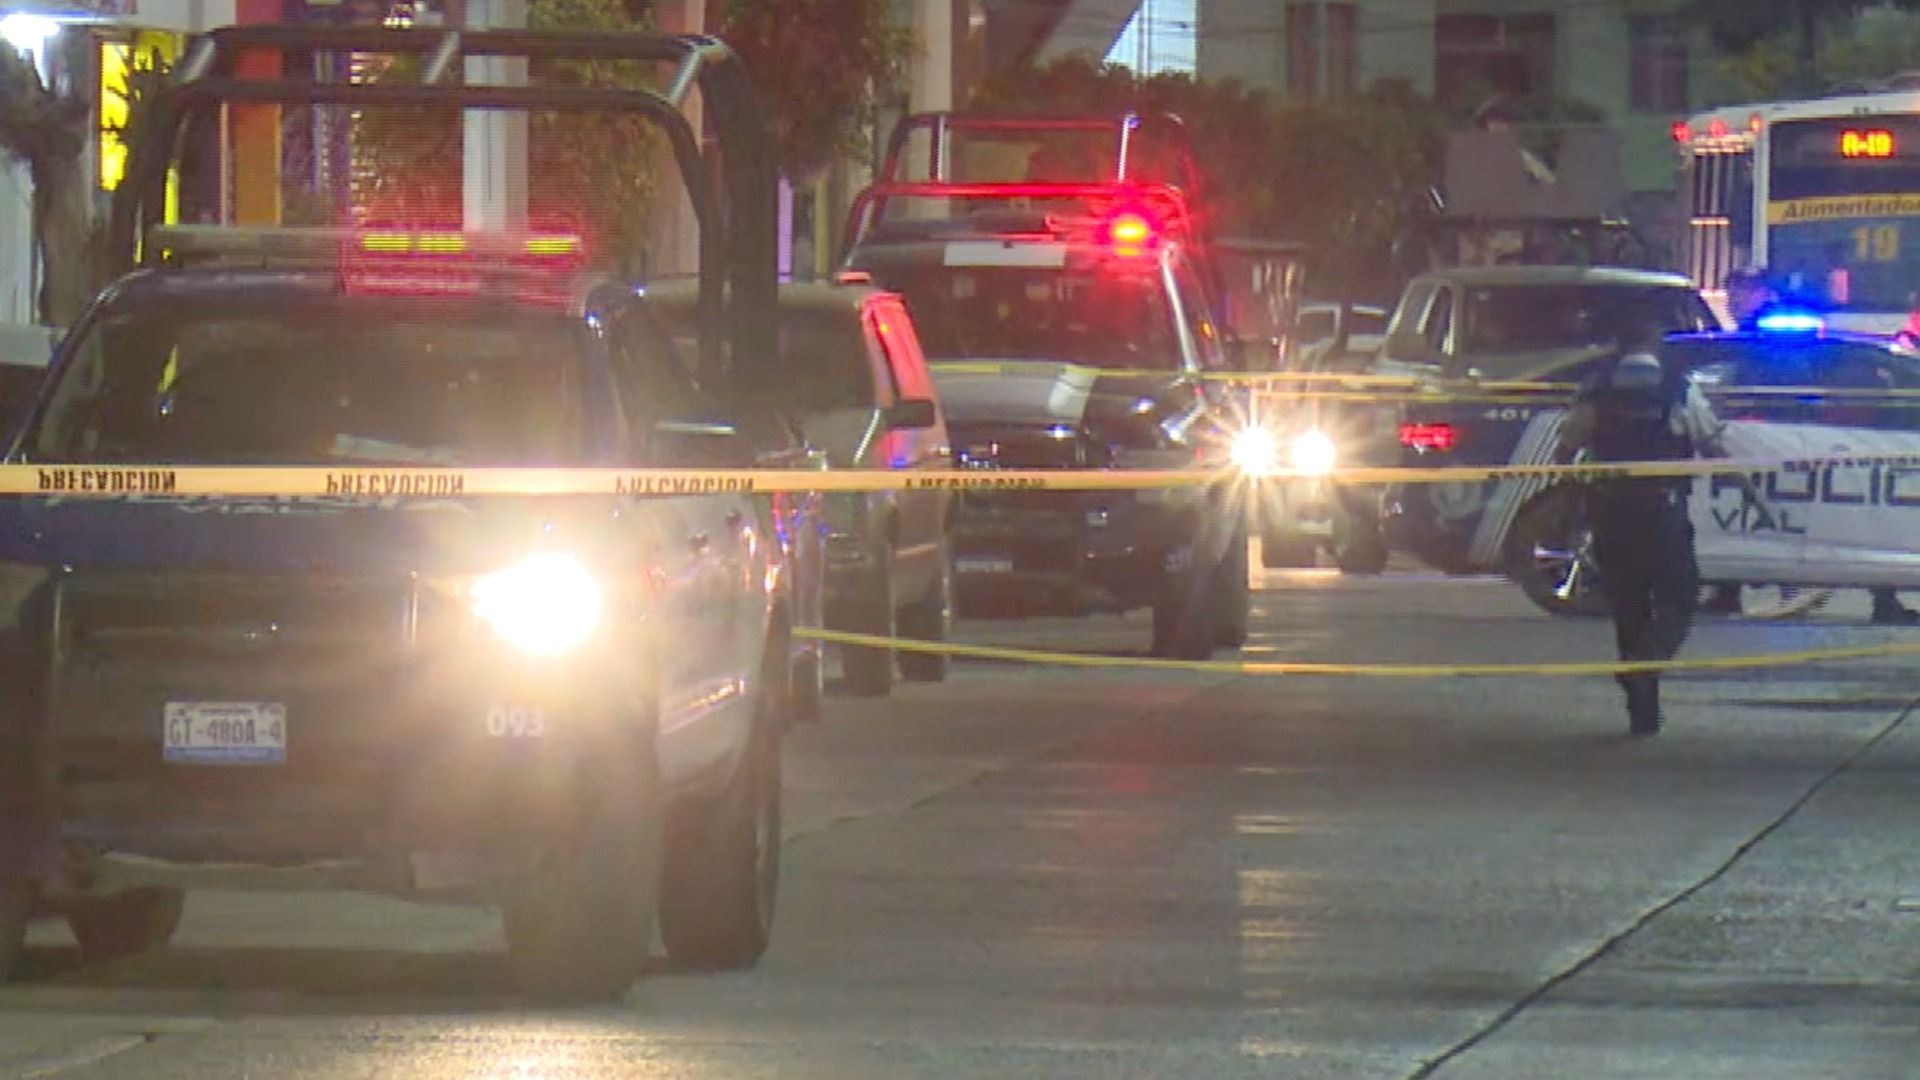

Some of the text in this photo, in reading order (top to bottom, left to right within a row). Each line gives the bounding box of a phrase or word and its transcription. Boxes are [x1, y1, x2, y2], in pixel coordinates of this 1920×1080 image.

[1854, 224, 1899, 261] 19
[1711, 508, 1806, 534] VIAL
[487, 707, 543, 738] 093
